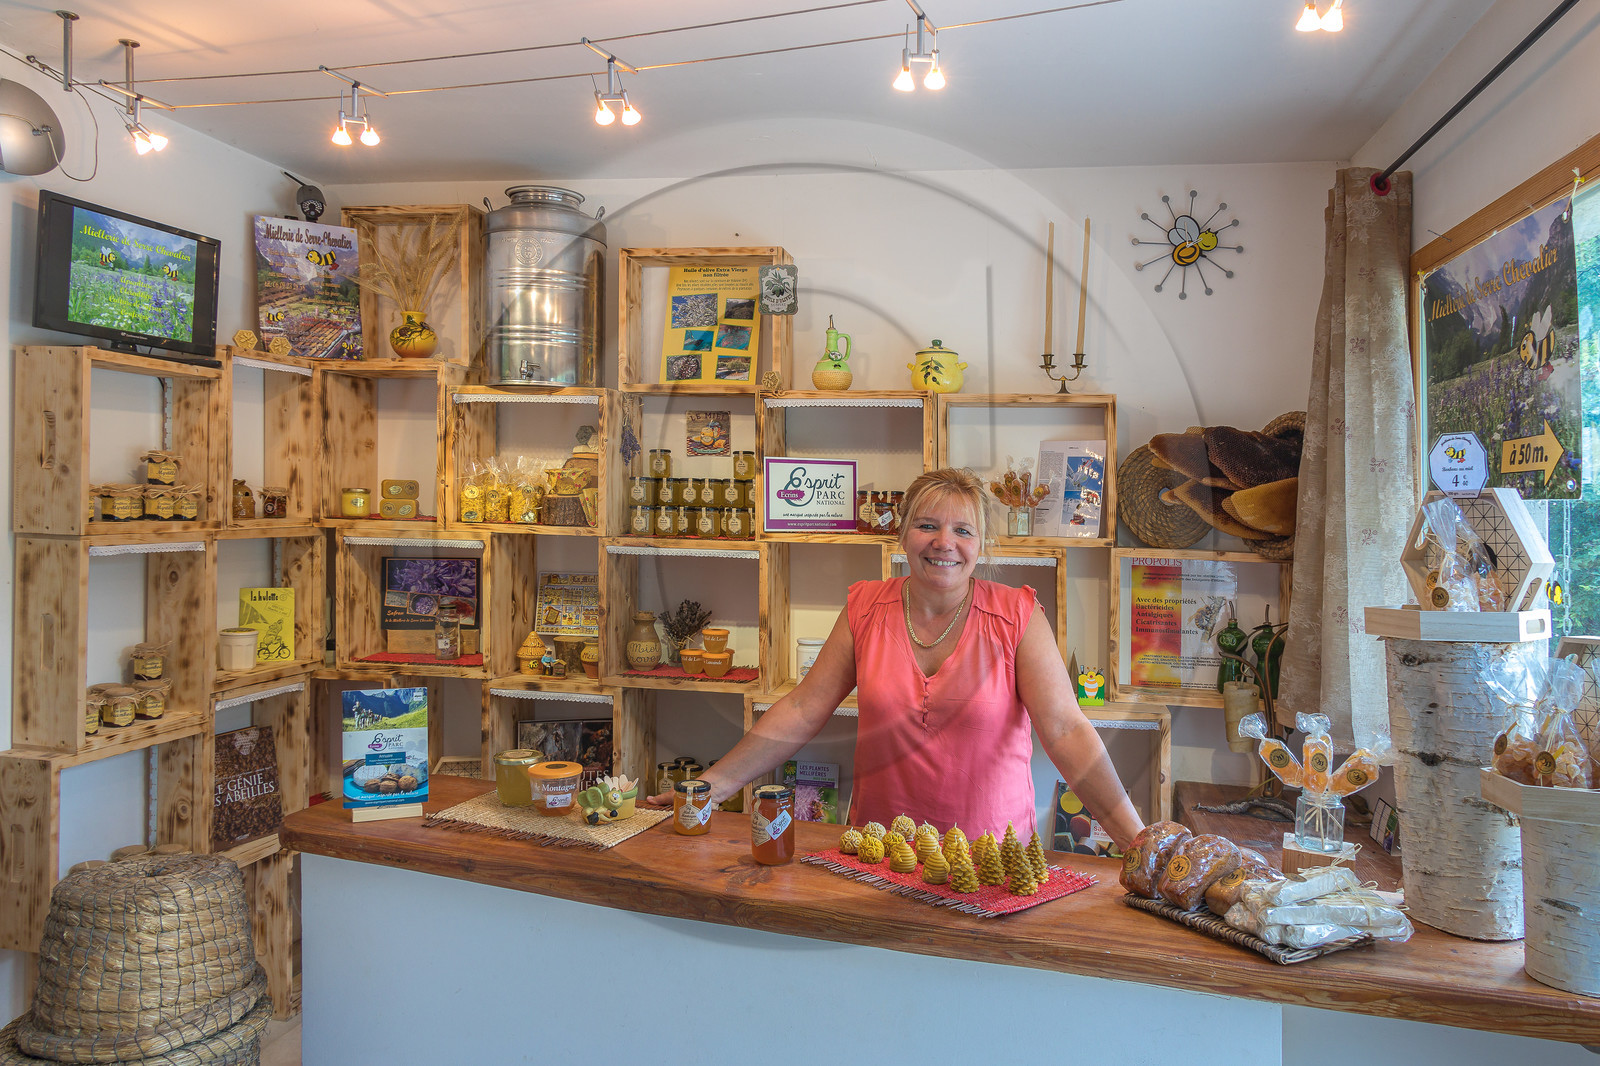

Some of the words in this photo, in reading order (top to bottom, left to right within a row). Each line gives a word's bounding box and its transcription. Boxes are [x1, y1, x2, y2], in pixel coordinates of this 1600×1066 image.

[264, 223, 294, 242] Miellerie
[295, 228, 303, 244] de
[80, 225, 120, 243] Miellerie
[122, 236, 131, 246] de
[134, 239, 154, 252] Serre
[156, 244, 191, 262] Chevalier
[1428, 290, 1467, 322] Miellerie
[1465, 283, 1476, 305] de
[1475, 275, 1502, 300] Serre
[1502, 243, 1559, 287] Chevalier
[1509, 444, 1517, 466] à
[784, 466, 845, 507] Esprit
[1452, 474, 1460, 487] 4
[816, 490, 845, 500] PARC
[1132, 557, 1183, 567] PROPOLIS
[250, 590, 257, 601] la
[257, 590, 279, 602] hulotte
[1164, 598, 1197, 608] propriétés
[1136, 611, 1174, 619] Antalgiques
[1135, 626, 1199, 635] Immunostimulantes
[371, 733, 404, 751] Esprit
[227, 772, 264, 791] GÉNIE
[542, 783, 577, 793] Montagne
[225, 781, 275, 804] ABEILLES
